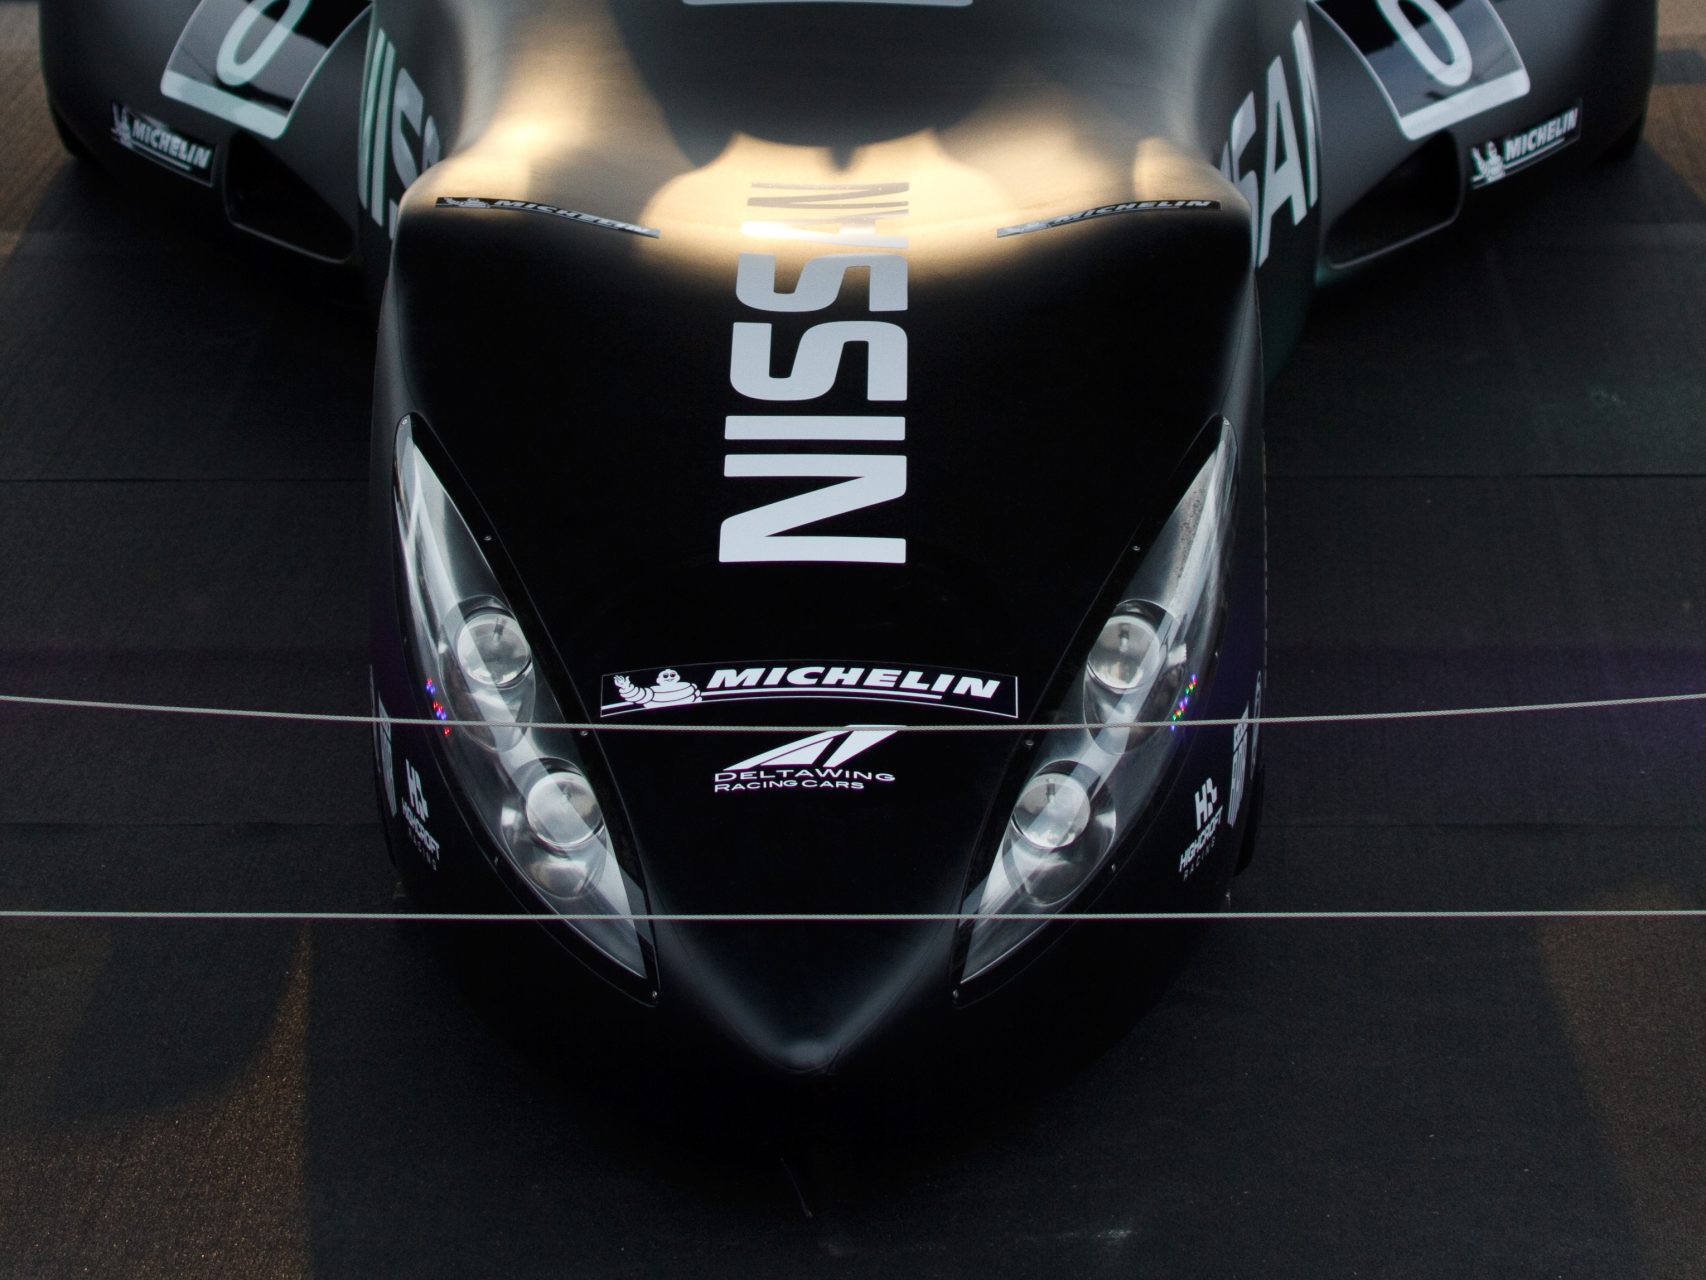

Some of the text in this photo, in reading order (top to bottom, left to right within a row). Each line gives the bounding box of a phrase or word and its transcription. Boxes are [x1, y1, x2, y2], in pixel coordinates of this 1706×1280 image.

[132, 119, 213, 171] MICHELIN
[1504, 107, 1579, 161] MICHELIN
[706, 666, 1001, 699] MICHELIN
[714, 767, 896, 783] DELTAWING
[714, 779, 865, 793] RACING CARS
